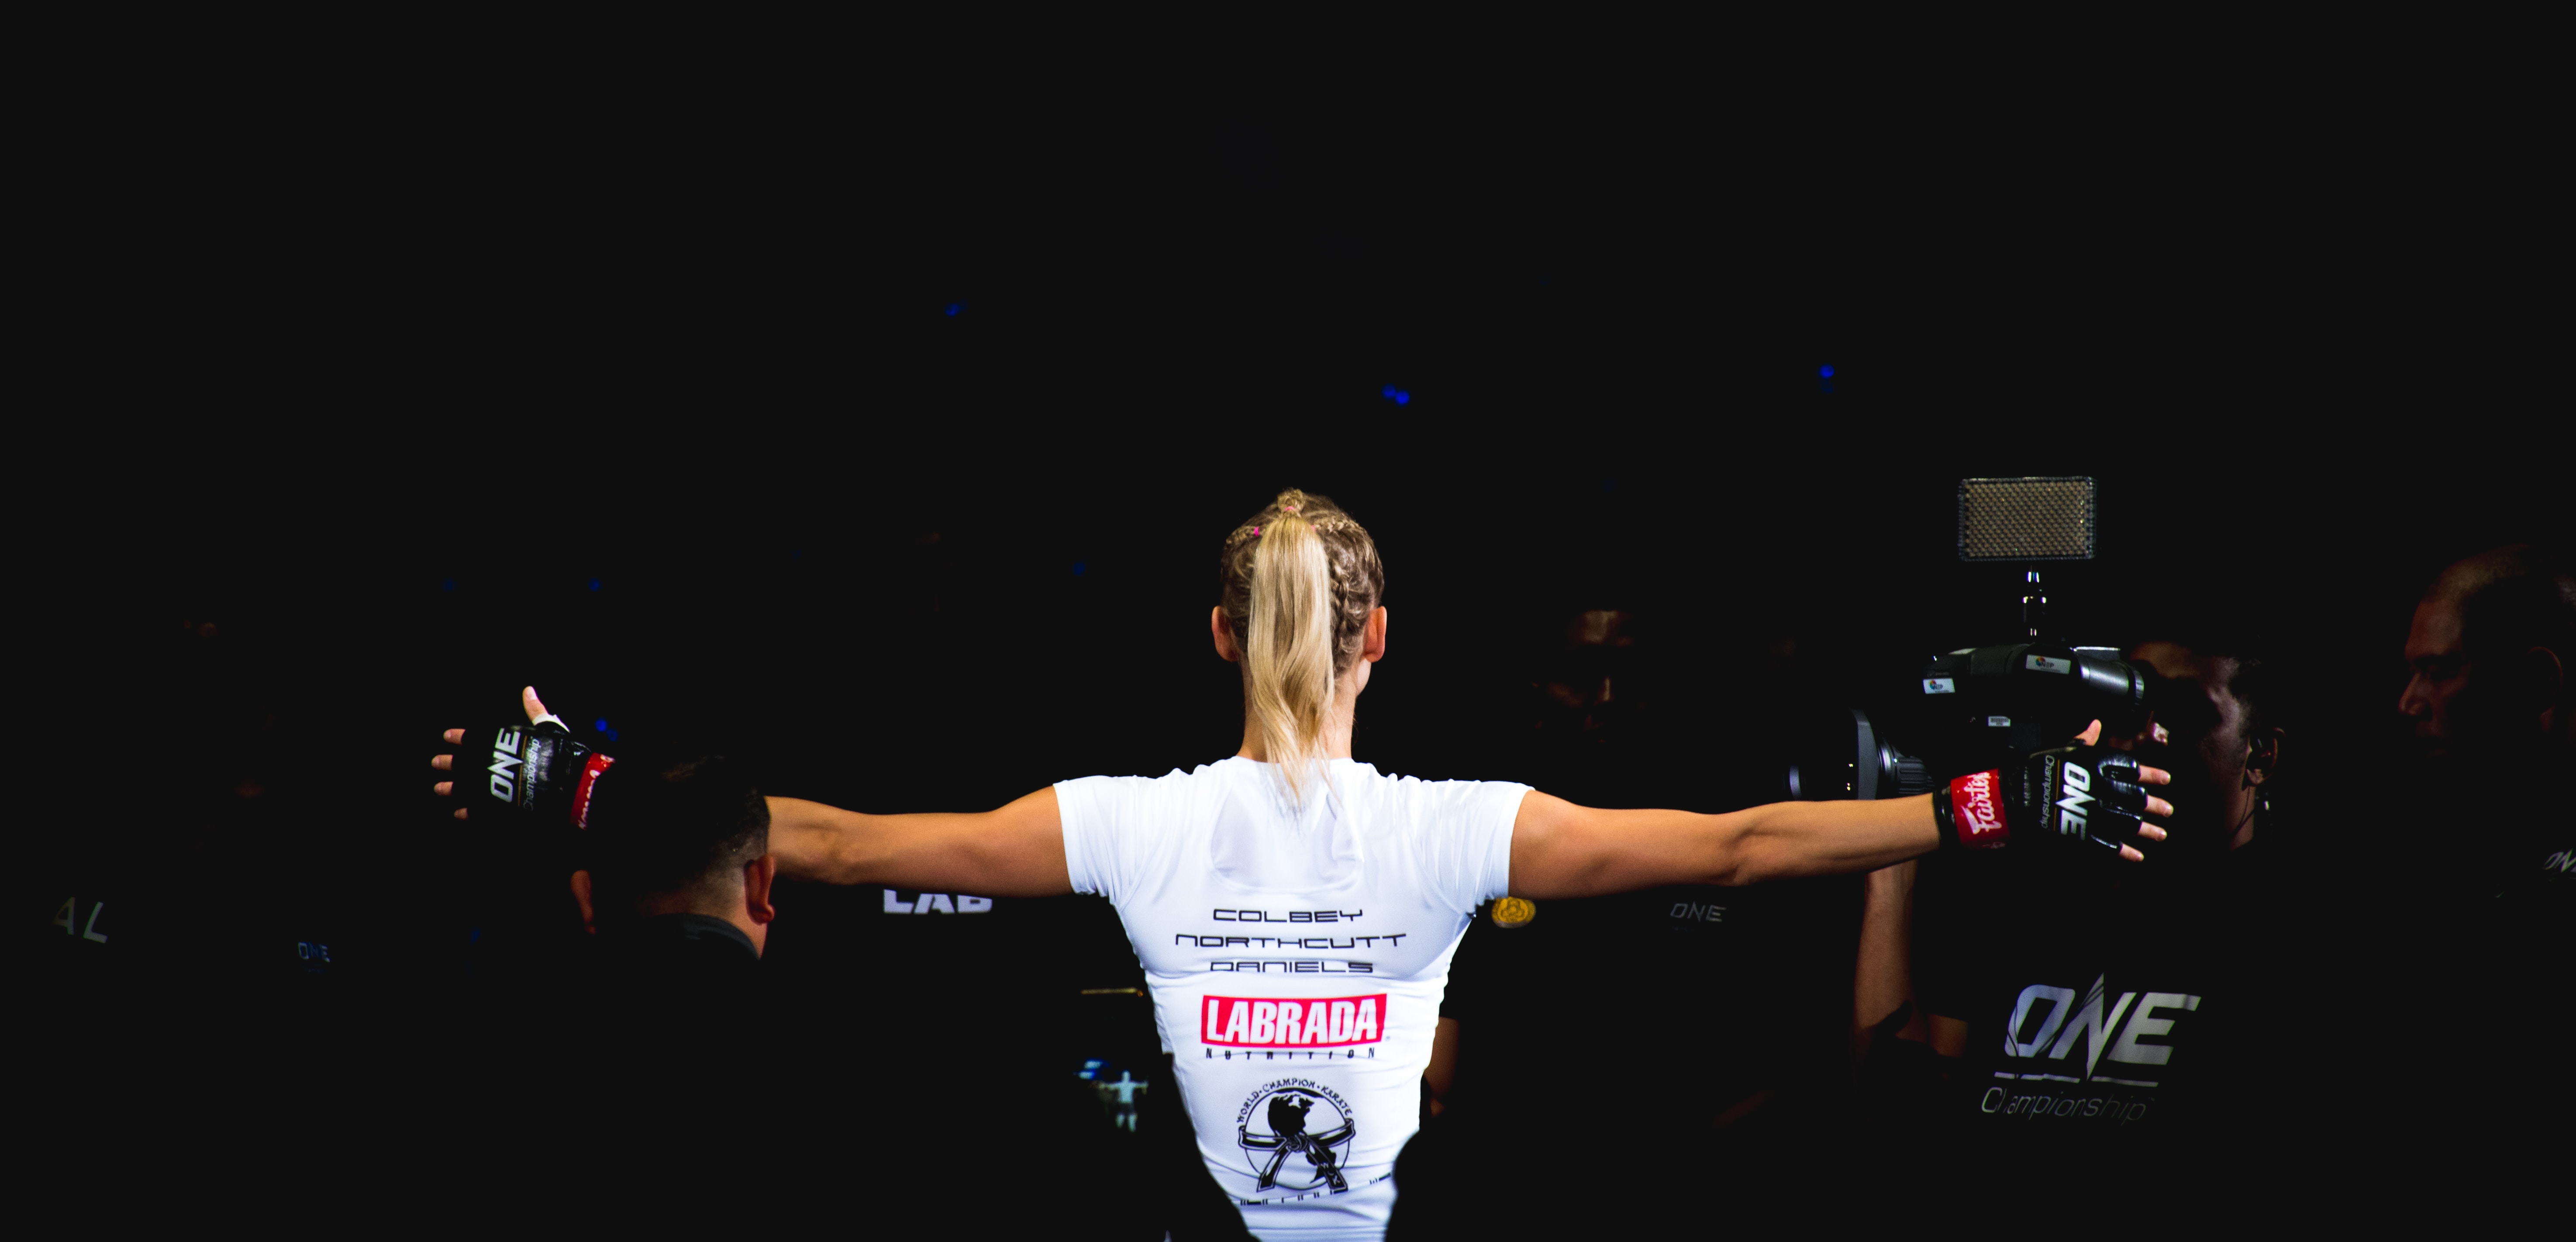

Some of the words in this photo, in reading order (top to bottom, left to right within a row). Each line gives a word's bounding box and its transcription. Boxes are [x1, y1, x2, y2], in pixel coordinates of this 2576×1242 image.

[486, 728, 524, 803] ONE
[2039, 755, 2055, 829] Championship
[2055, 761, 2096, 841] ONE
[1213, 909, 1362, 923] COLBEY
[1669, 900, 1728, 923] ONE
[1176, 934, 1407, 949] NORTHCUTT
[1210, 962, 1373, 973] DANIELS
[1207, 998, 1377, 1044] LABRADA
[2004, 972, 2202, 1081] ONE
[1206, 1047, 1375, 1060] NUTRITION
[1236, 1090, 1259, 1123] WORLD
[1262, 1078, 1316, 1093] CHAMPION
[1321, 1085, 1353, 1117] KARATE
